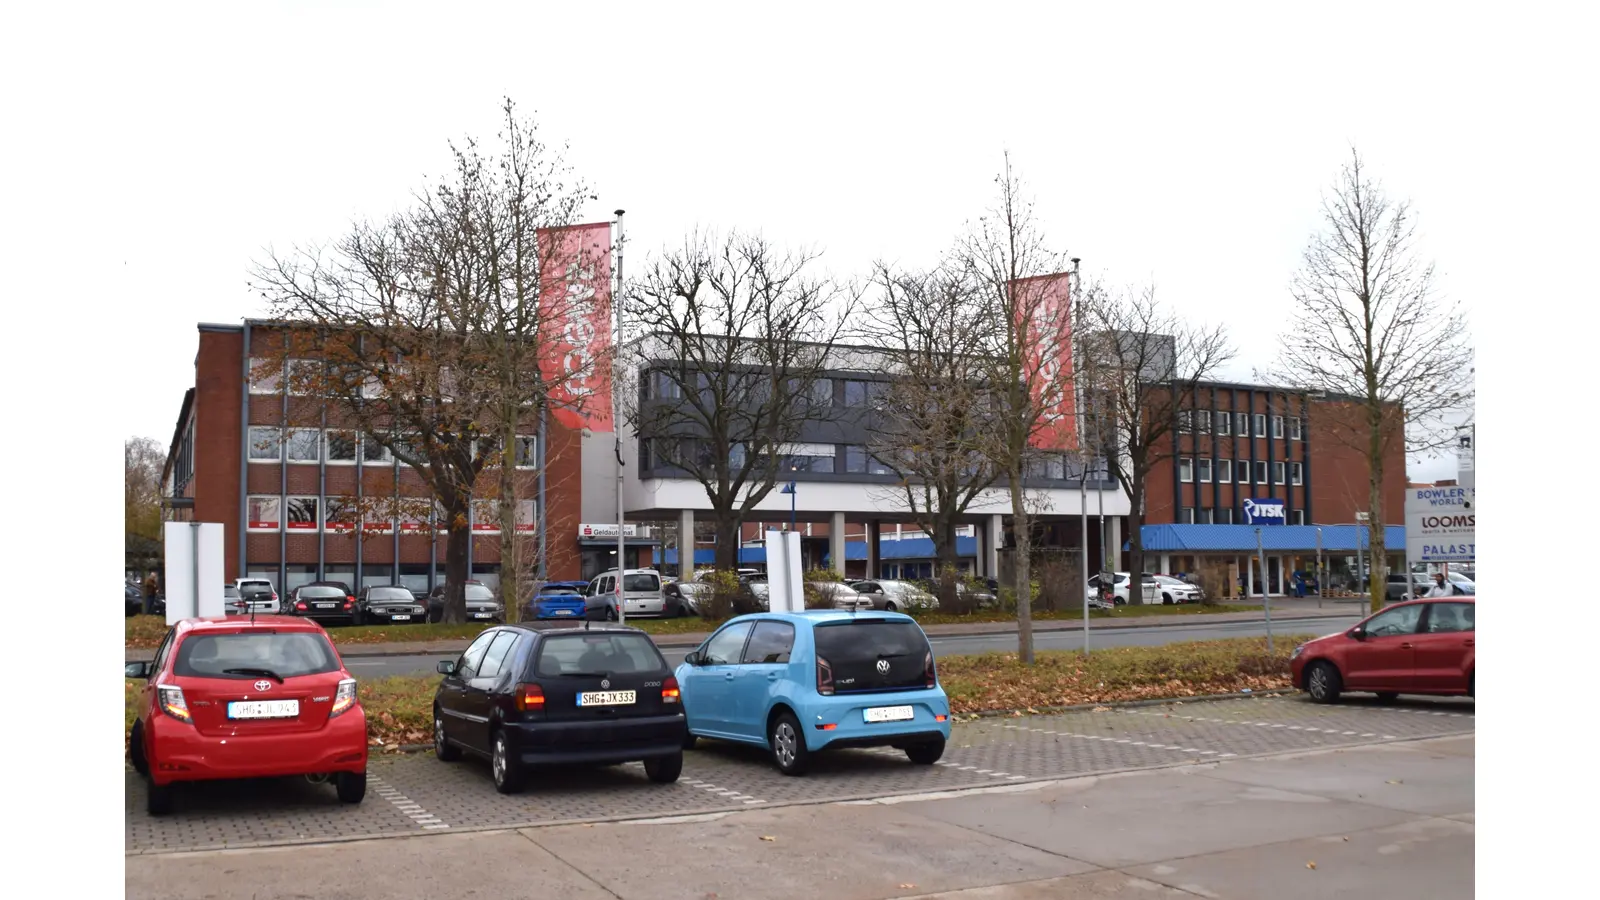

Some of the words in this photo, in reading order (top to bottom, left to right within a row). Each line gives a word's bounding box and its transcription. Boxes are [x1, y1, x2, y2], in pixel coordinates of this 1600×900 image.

[1429, 498, 1465, 506] WORLD
[1252, 504, 1284, 517] JYSK
[1421, 515, 1475, 528] LOOMS
[1423, 544, 1475, 555] PALAST
[583, 694, 600, 704] SHG
